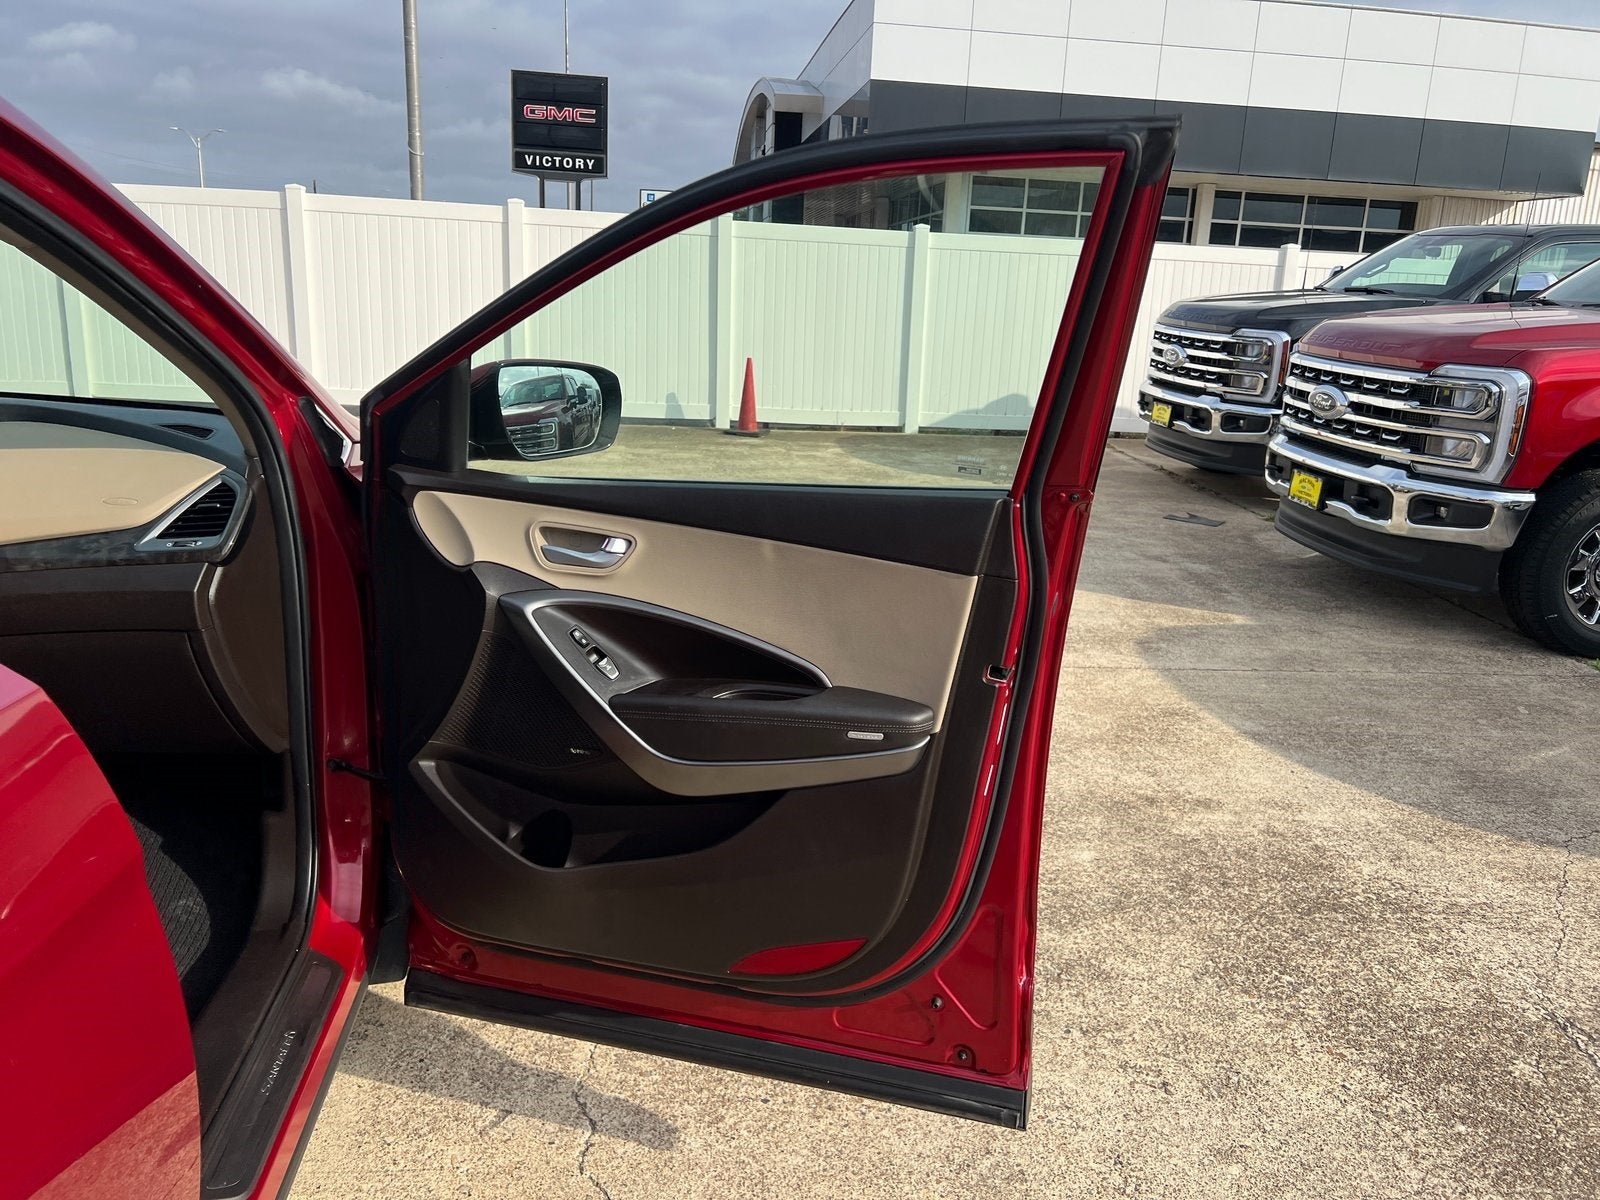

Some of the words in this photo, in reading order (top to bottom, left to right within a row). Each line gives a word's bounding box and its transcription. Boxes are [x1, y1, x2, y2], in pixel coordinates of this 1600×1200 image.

[523, 104, 597, 124] GMC
[524, 154, 596, 170] VICTORY
[1313, 393, 1332, 410] Ford
